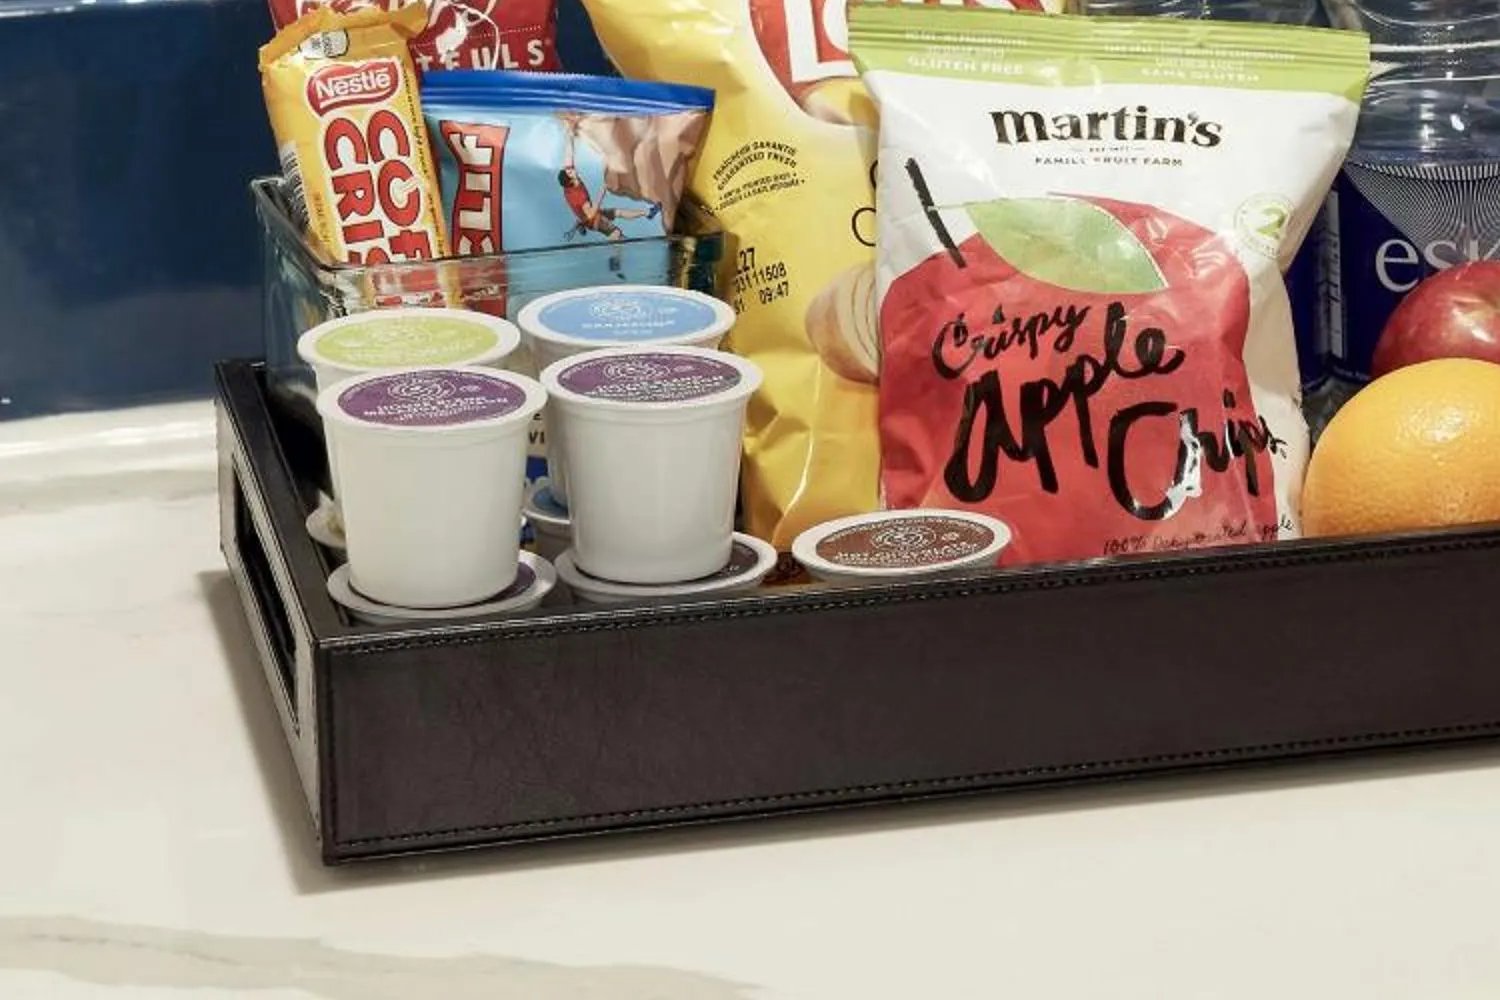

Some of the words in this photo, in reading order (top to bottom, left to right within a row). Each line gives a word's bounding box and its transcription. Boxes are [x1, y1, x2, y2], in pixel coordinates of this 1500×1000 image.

[315, 68, 392, 100] Nestlé
[908, 56, 978, 72] GLUTEN
[981, 63, 1024, 75] FREE
[989, 105, 1224, 148] martin's
[1144, 157, 1183, 166] FARM
[932, 304, 1092, 379] Crispy
[943, 302, 1185, 504] Apple
[1107, 388, 1288, 521] Chips
[1102, 534, 1148, 556] 100%
